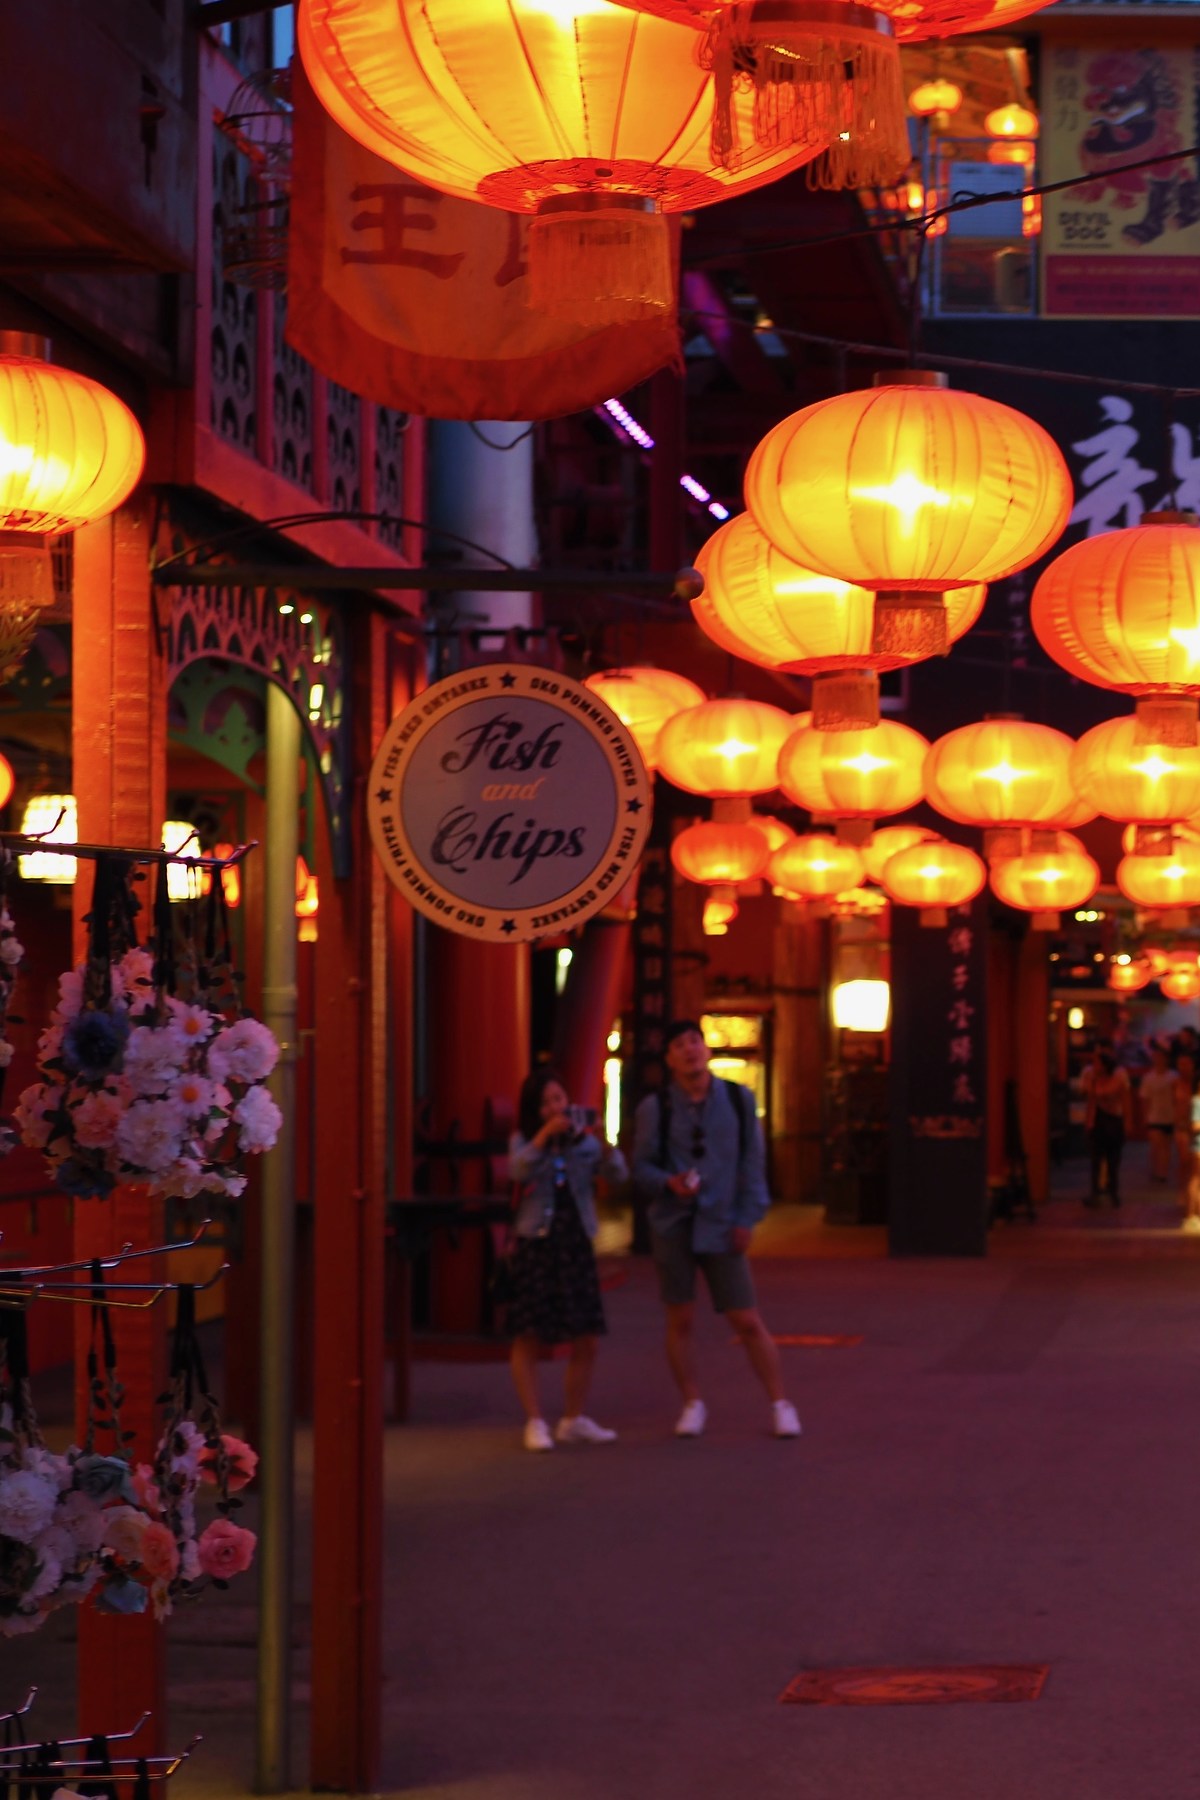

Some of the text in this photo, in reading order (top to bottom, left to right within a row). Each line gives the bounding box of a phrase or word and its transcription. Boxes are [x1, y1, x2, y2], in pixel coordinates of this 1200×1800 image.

[1058, 212, 1111, 226] DEVIL
[1064, 226, 1107, 240] DOG
[381, 675, 489, 779] FISK MED OMTANKE
[441, 712, 565, 774] Fish
[560, 687, 615, 736] POMMES
[608, 734, 637, 786] FRITES
[481, 776, 546, 801] and
[380, 815, 407, 868] FRITES
[430, 805, 587, 886] Chips
[614, 826, 636, 861] FISK
[401, 866, 455, 917] POMMES
[594, 860, 622, 893] MED
